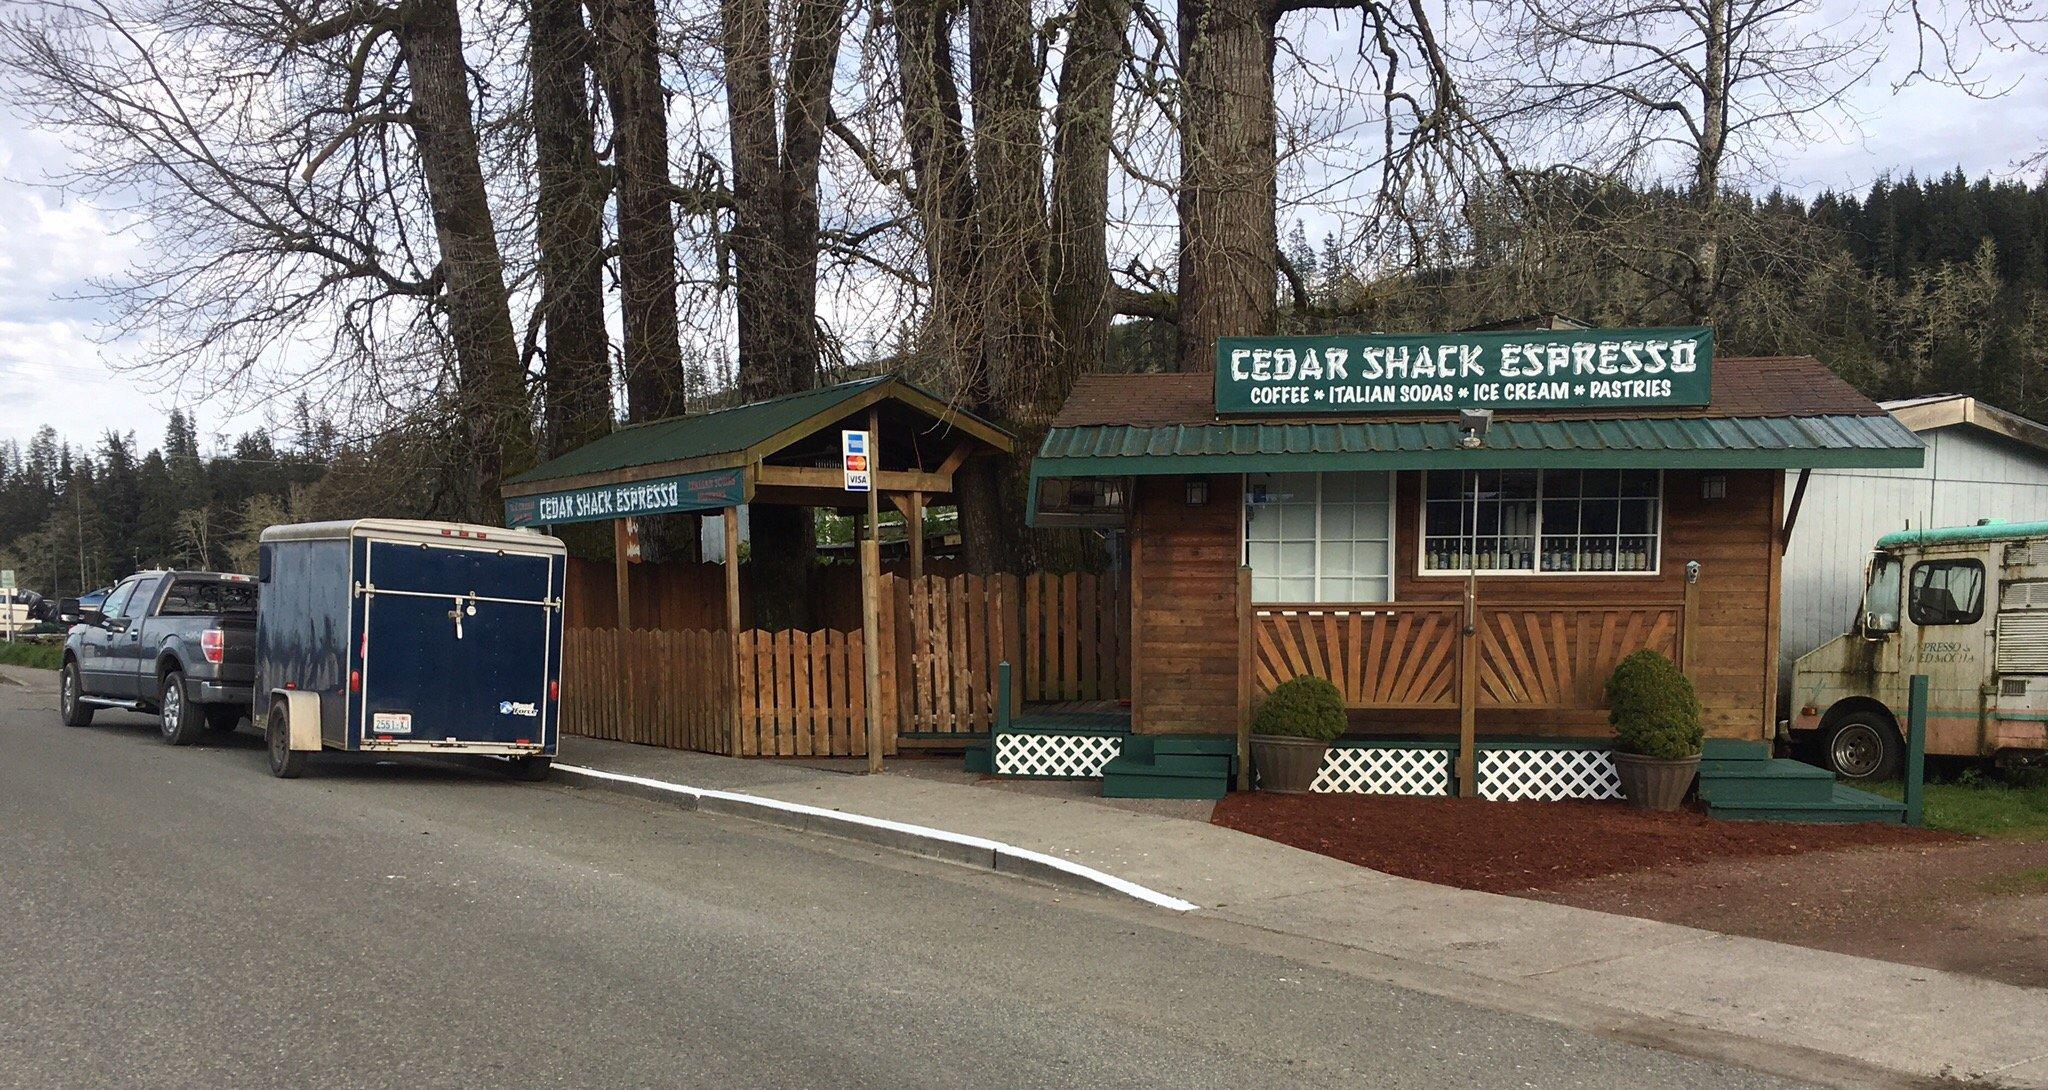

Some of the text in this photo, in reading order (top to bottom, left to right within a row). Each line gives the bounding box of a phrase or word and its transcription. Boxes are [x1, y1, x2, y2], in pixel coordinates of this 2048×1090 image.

[1231, 339, 1698, 381] CEDAR SHACK ESPRESSO
[1250, 379, 1672, 405] COFFEE ITALIAN SODAS ICE CREAM PASTRIES
[850, 475, 867, 483] VISA
[539, 496, 574, 520] CEDAR
[577, 491, 612, 517] SHACK
[616, 482, 679, 512] ESPRESSO
